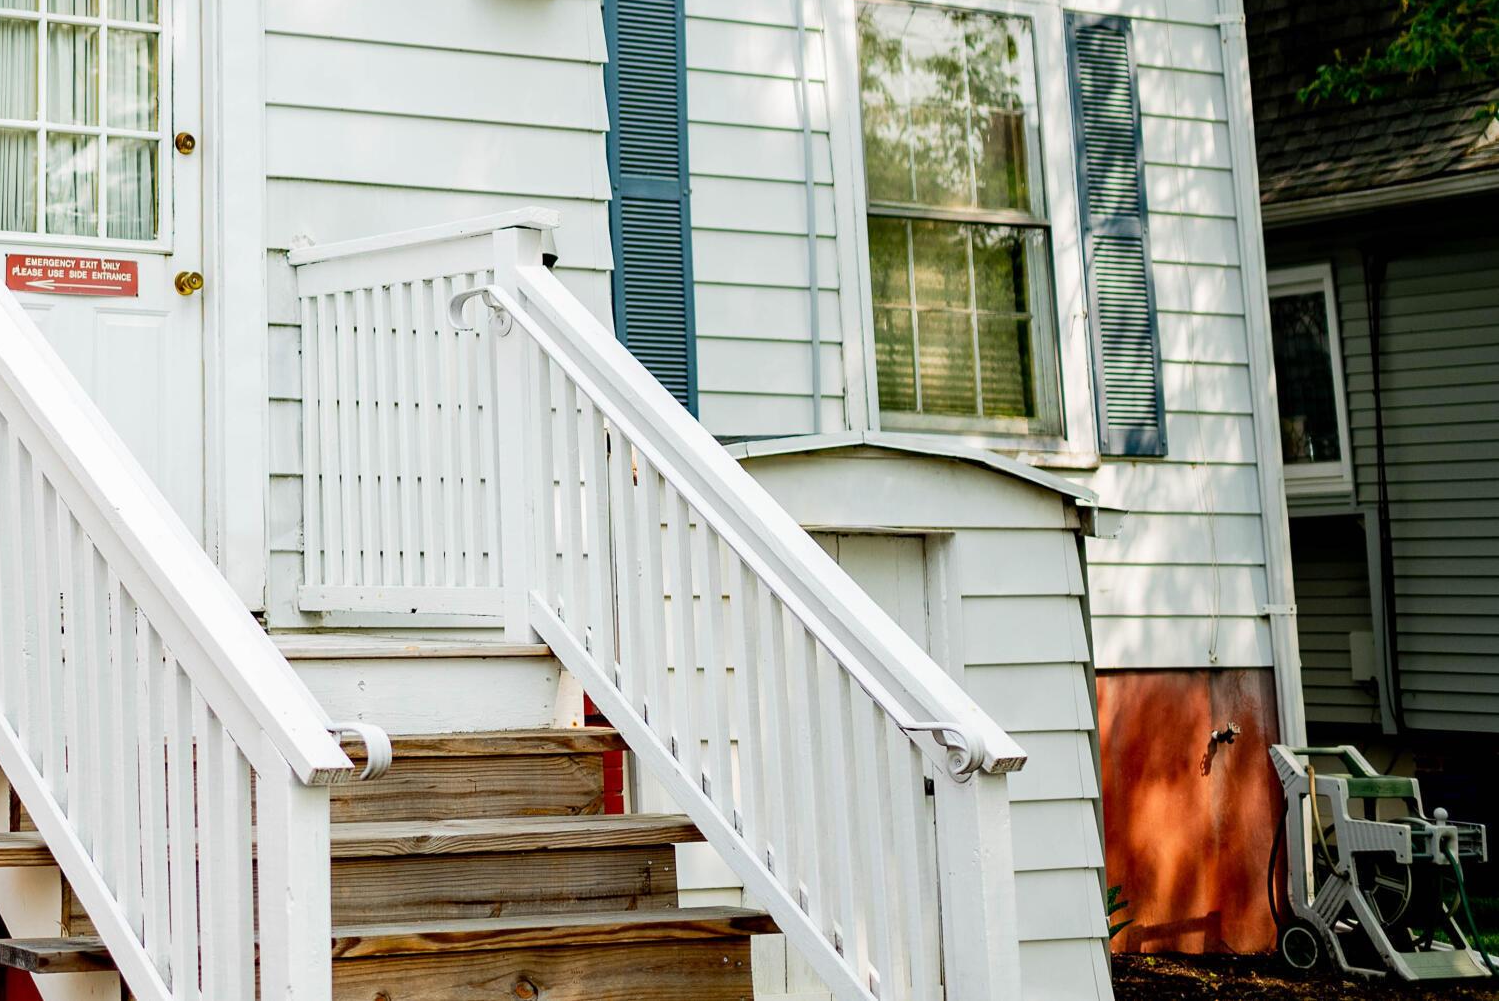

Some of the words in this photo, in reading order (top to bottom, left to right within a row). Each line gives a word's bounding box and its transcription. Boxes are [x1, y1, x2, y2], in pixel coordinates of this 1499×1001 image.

[25, 257, 76, 269] EMERGENCY
[80, 259, 98, 269] EXIT
[101, 261, 121, 270] ONLY
[12, 266, 43, 277] PLEASE
[48, 268, 64, 278] USE
[69, 270, 88, 280] SIDE
[92, 271, 132, 282] ENTRANCE
